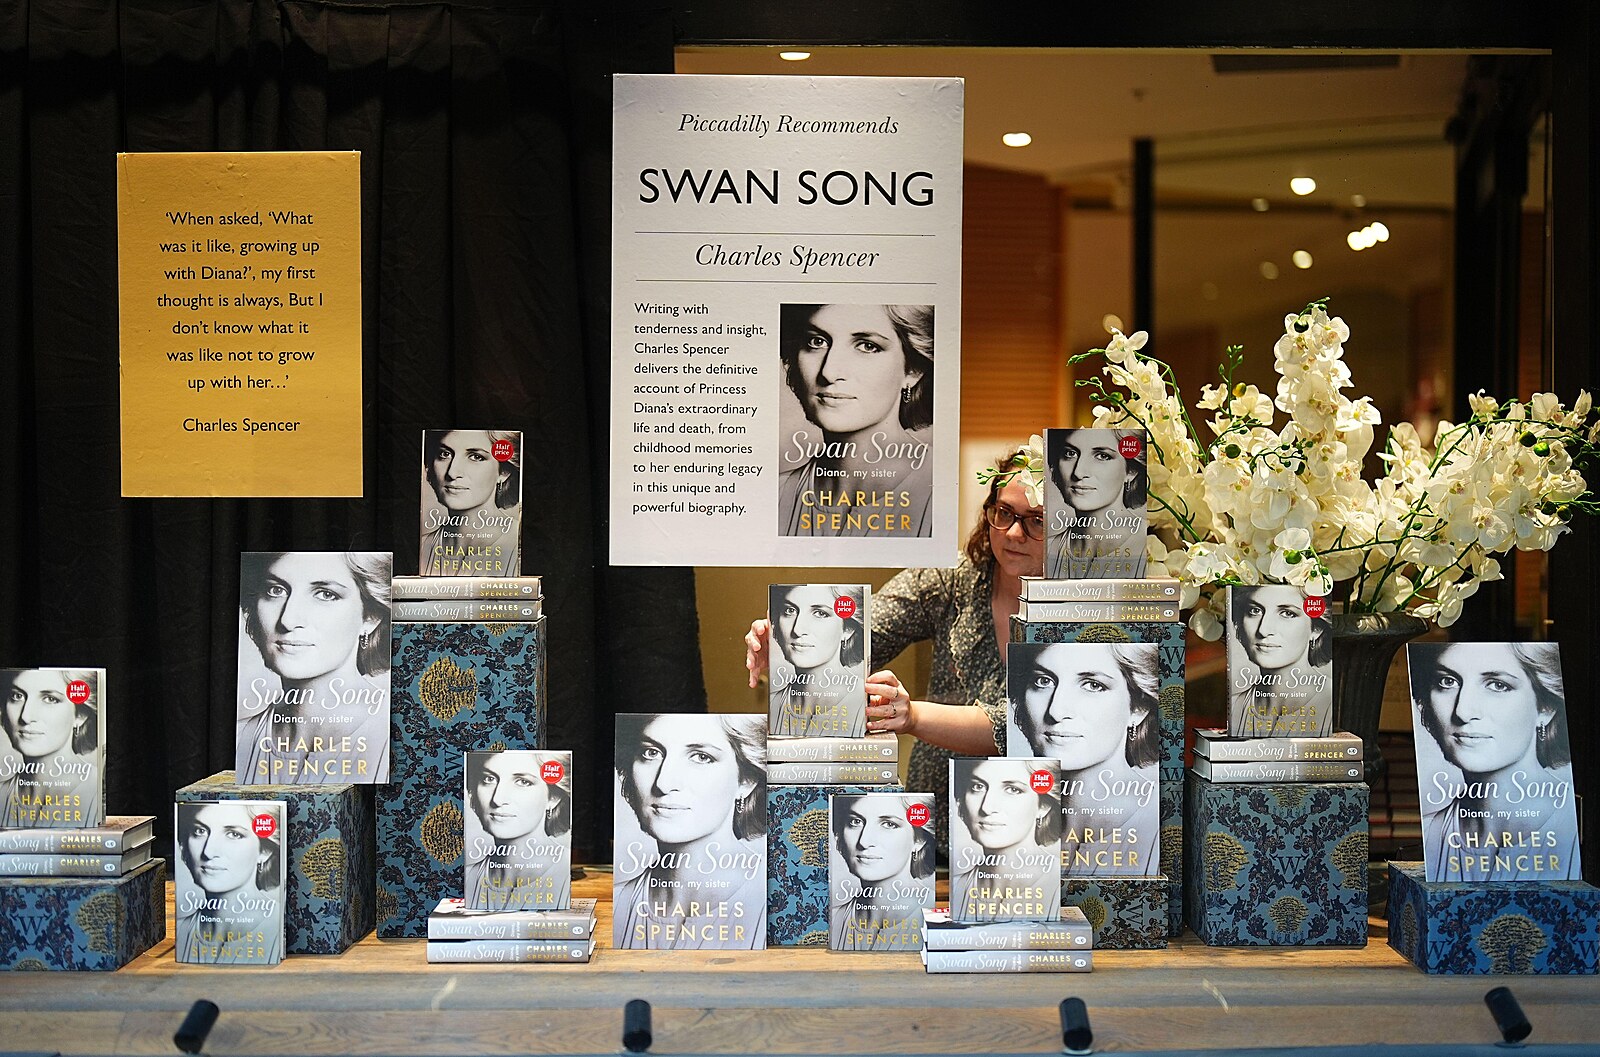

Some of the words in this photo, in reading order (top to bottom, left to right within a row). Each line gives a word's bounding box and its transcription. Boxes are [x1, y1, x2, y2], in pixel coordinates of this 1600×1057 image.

[678, 114, 770, 138] Piccadilly
[776, 115, 899, 134] Recommends
[639, 169, 779, 204] SWAN
[798, 170, 934, 205] SONG
[219, 212, 262, 227] asked,
[159, 242, 186, 253] was
[192, 239, 201, 253] it
[207, 239, 235, 254] like,
[240, 240, 297, 255] growing
[302, 242, 319, 255] up
[696, 245, 782, 266] Charles
[790, 246, 880, 273] Spencer
[164, 266, 196, 280] with
[261, 270, 282, 283] my
[286, 266, 315, 280] first
[157, 294, 213, 310] thought
[218, 295, 229, 307] is
[234, 294, 283, 310] always,
[289, 294, 314, 307] But
[319, 294, 323, 306] I
[635, 303, 679, 316] Writing
[683, 304, 709, 314] with
[214, 321, 253, 334] know
[258, 321, 294, 334] what
[299, 321, 309, 334] it
[634, 324, 697, 335] tenderness
[702, 324, 723, 335] and
[727, 324, 767, 337] insight,
[167, 350, 194, 361] was
[199, 348, 223, 361] like
[228, 349, 252, 361] not
[258, 349, 273, 361] to
[278, 350, 315, 364] grow
[634, 343, 679, 354] Charles
[683, 344, 729, 357] Spencer
[634, 363, 678, 374] delivers
[683, 364, 702, 374] the
[706, 364, 758, 375] definitive
[187, 378, 205, 391] up
[210, 375, 242, 389] with
[633, 384, 679, 394] account
[683, 383, 696, 394] of
[699, 384, 746, 394] Princess
[678, 404, 757, 417] extraordinary
[183, 418, 237, 432] Charles
[242, 418, 300, 434] Spencer
[633, 422, 650, 434] life
[654, 422, 675, 434] and
[679, 423, 714, 435] death,
[718, 423, 746, 434] from
[633, 442, 690, 453] childhood
[695, 443, 753, 454] memories
[784, 431, 857, 463] Swan
[864, 432, 928, 470] Song
[633, 463, 645, 473] to
[650, 462, 669, 473] her
[673, 463, 724, 476] enduring
[728, 463, 763, 477] legacy
[816, 467, 849, 478] Diana,
[853, 470, 868, 479] my
[871, 468, 896, 478] sister
[633, 482, 643, 492] in
[648, 482, 668, 493] this
[672, 483, 710, 495] unique
[715, 483, 735, 493] and
[802, 491, 911, 507] CHARLES
[633, 502, 684, 515] powerful
[688, 502, 746, 516] biography.
[425, 509, 469, 529] Swan
[473, 510, 513, 533] Song
[800, 514, 911, 530] SPENCER
[1051, 510, 1097, 531] Swan
[1101, 510, 1142, 534] Song
[435, 546, 501, 556] CHARLES
[434, 560, 502, 570] SPENCER
[395, 604, 428, 618] Swan
[430, 604, 460, 620] Song
[773, 667, 816, 687] Swan
[819, 667, 859, 692] Song
[1235, 668, 1282, 689] Swan
[1286, 668, 1327, 692] Song
[70, 690, 86, 698] price
[71, 684, 85, 692] Half
[243, 678, 315, 710] Swan
[321, 678, 385, 715] Song
[274, 714, 306, 724] Diana,
[311, 716, 325, 725] my
[260, 737, 367, 752] CHARLES
[0, 755, 44, 776] Swan
[49, 755, 92, 781] Song
[258, 760, 367, 775] SPENCER
[1033, 780, 1049, 788] price
[1091, 770, 1155, 807] Song
[1427, 772, 1500, 804] Swan
[1506, 771, 1569, 809] Song
[1099, 807, 1124, 815] sister
[1460, 809, 1493, 819] Diana,
[1498, 810, 1512, 818] my
[1515, 809, 1540, 817] sister
[1066, 828, 1138, 844] ARLES
[1448, 831, 1557, 848] CHARLES
[469, 838, 518, 859] Swan
[521, 838, 564, 863] Song
[619, 842, 691, 874] Swan
[698, 842, 762, 880] Song
[957, 847, 1006, 869] Swan
[1011, 848, 1055, 873] Song
[1061, 851, 1139, 866] ENCER
[1449, 856, 1560, 872] SPENCER
[978, 872, 1001, 880] Diana,
[651, 878, 683, 889] Diana,
[688, 881, 702, 890] my
[836, 880, 883, 901] Swan
[887, 880, 930, 905] Song
[969, 888, 1043, 899] CHARLES
[180, 891, 227, 913] Swan
[232, 892, 276, 917] Song
[636, 902, 744, 917] CHARLES
[968, 903, 1044, 914] SPENCER
[635, 925, 745, 941] SPENCER
